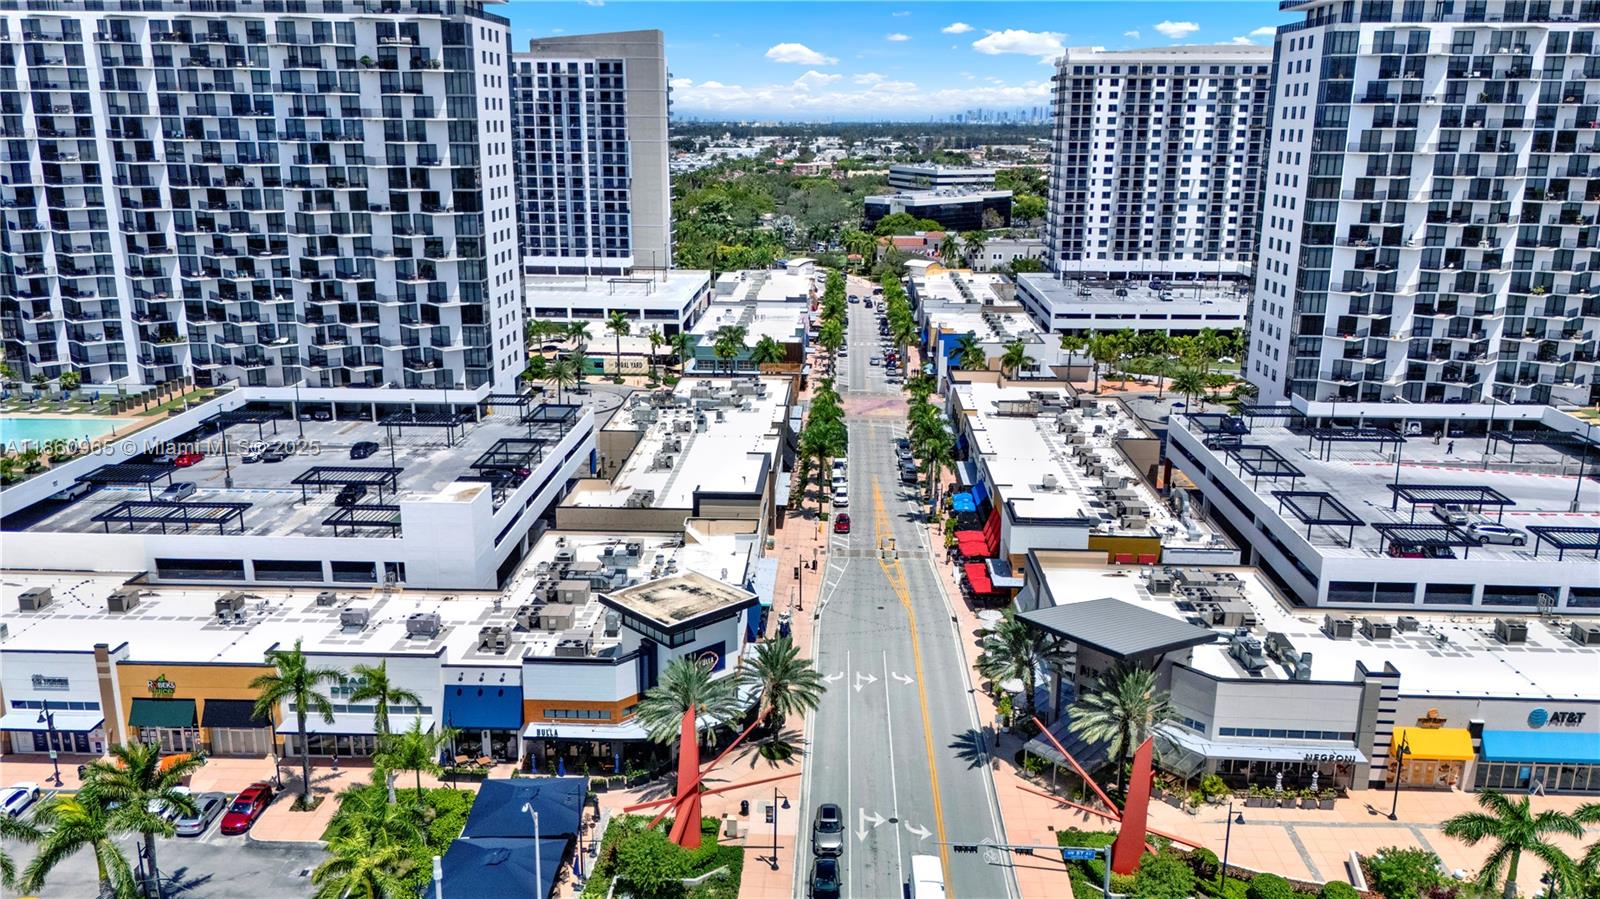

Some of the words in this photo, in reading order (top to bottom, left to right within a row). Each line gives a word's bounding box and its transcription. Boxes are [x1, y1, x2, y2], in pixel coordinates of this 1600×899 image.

[1550, 711, 1587, 724] AT&T
[536, 728, 559, 737] BULLA
[1304, 753, 1356, 762] NEGRONI
